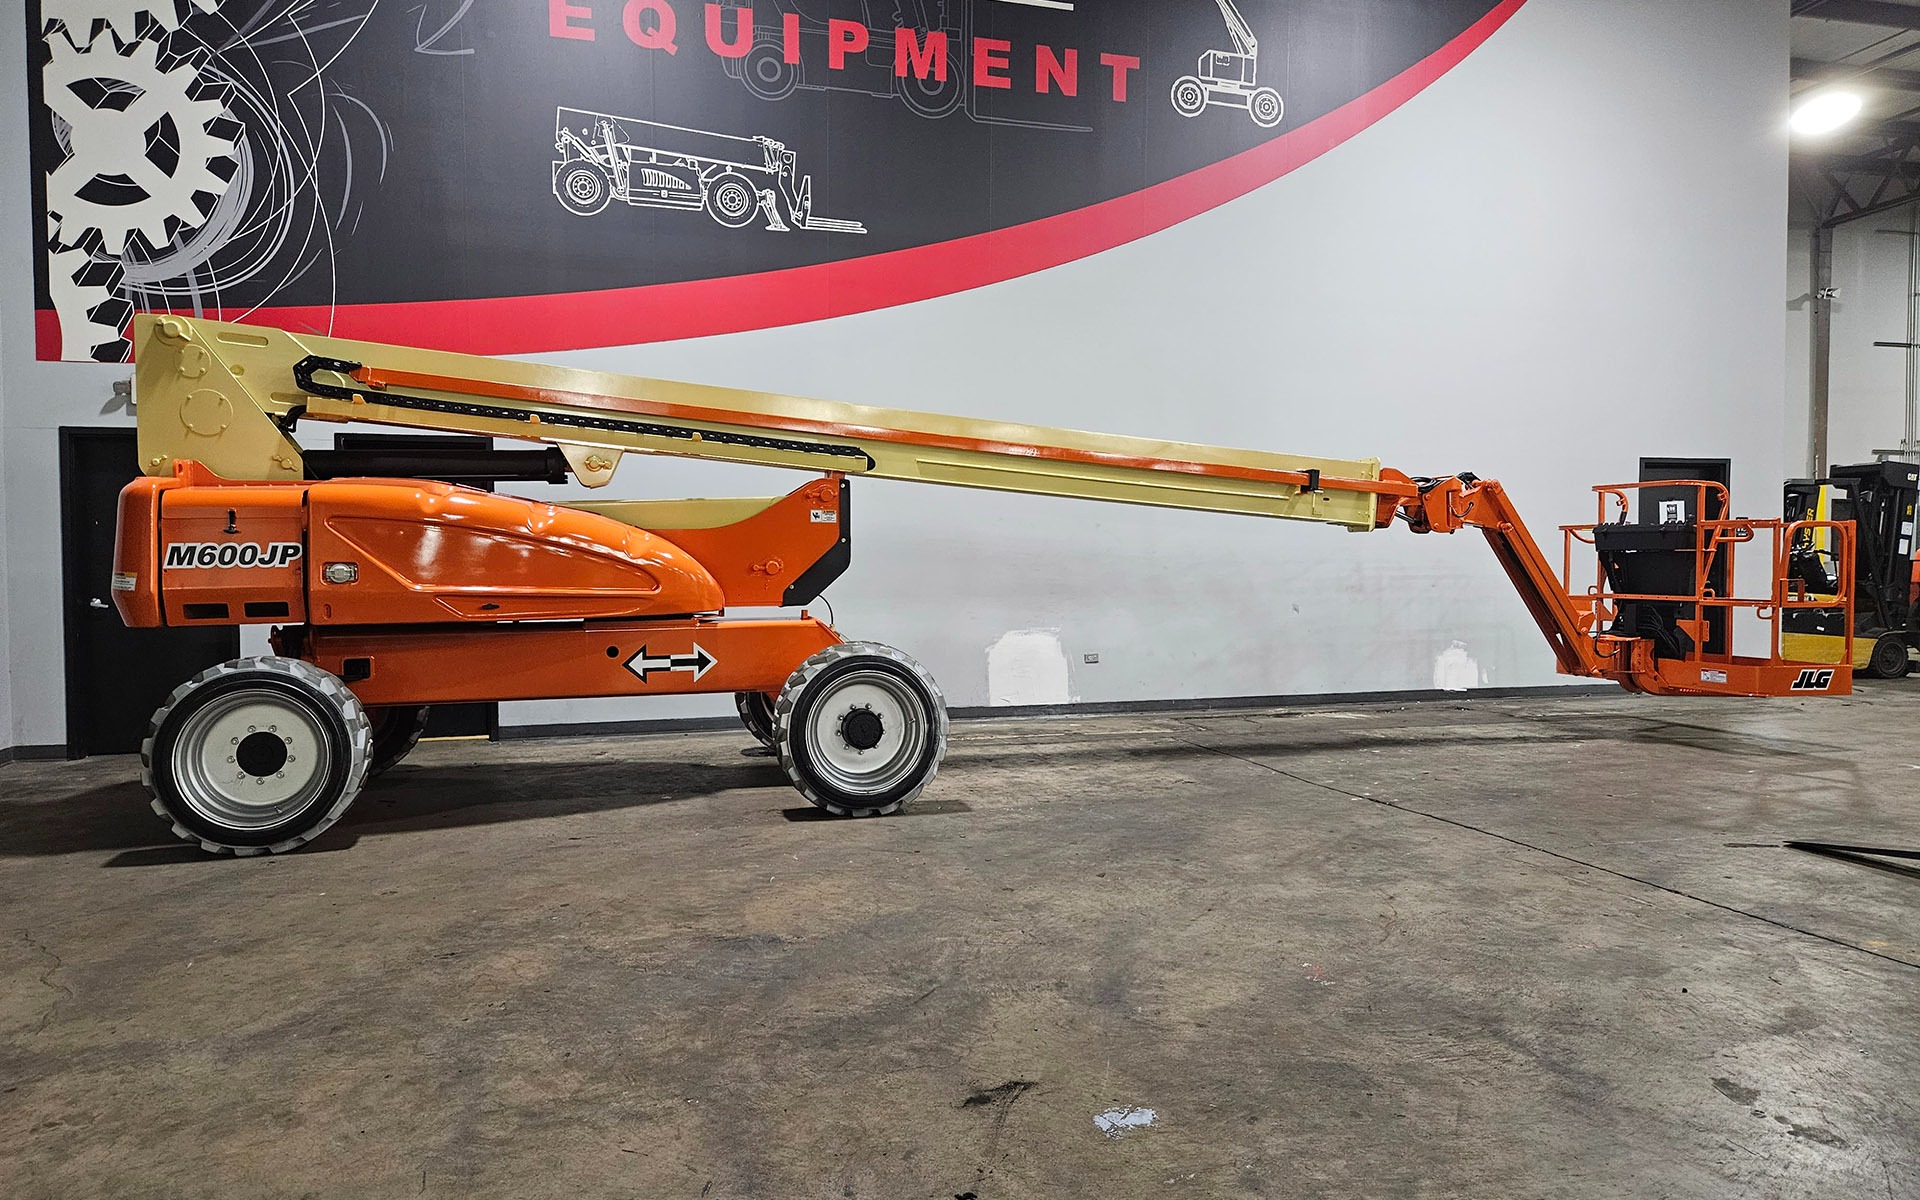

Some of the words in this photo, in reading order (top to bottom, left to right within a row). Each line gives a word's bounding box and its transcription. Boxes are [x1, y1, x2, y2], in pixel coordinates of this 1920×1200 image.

[549, 0, 1141, 102] EQUIPMENT
[1907, 473, 1918, 481] CAT
[164, 542, 302, 568] M600JP
[1791, 669, 1835, 690] JLG
